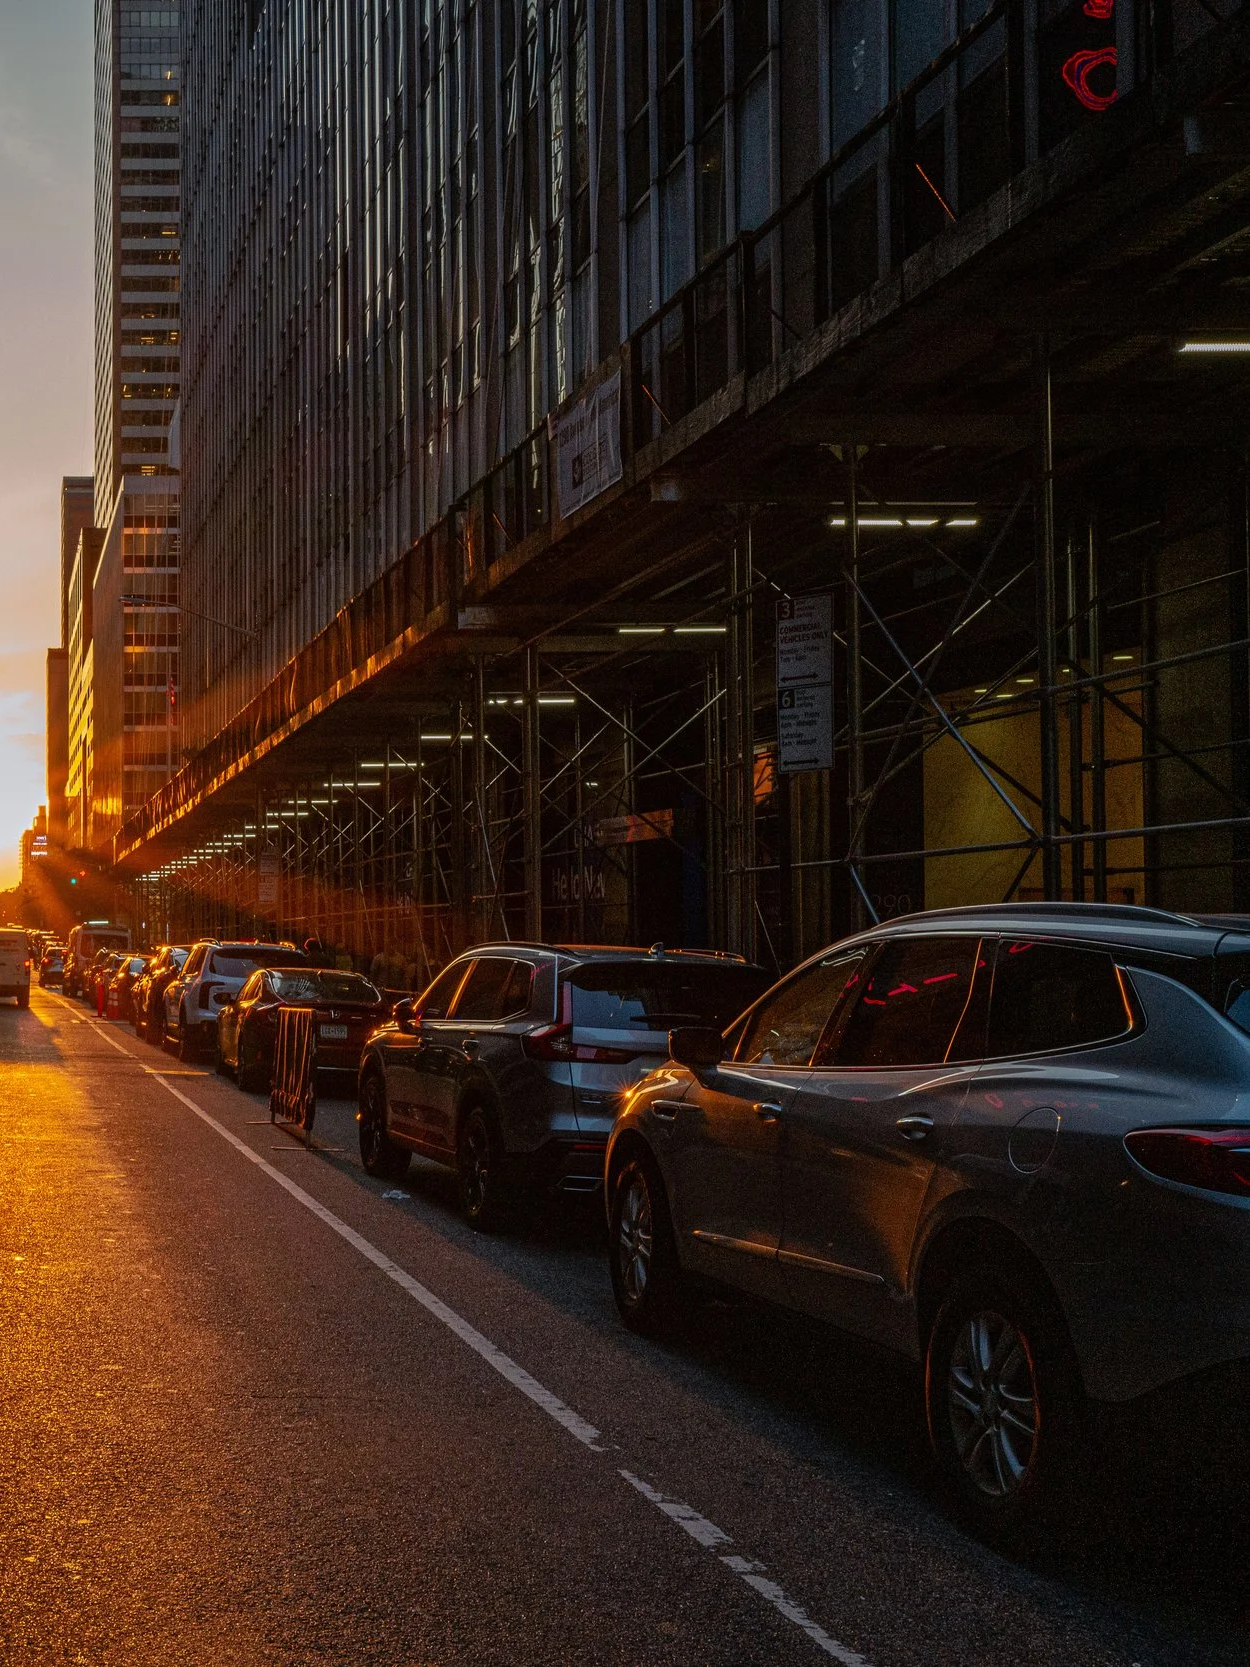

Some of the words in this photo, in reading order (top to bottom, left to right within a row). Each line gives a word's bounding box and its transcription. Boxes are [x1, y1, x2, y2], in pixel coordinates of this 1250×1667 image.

[780, 633, 810, 644] VEHICLES
[811, 631, 829, 640] ONLY
[781, 690, 791, 708] 6
